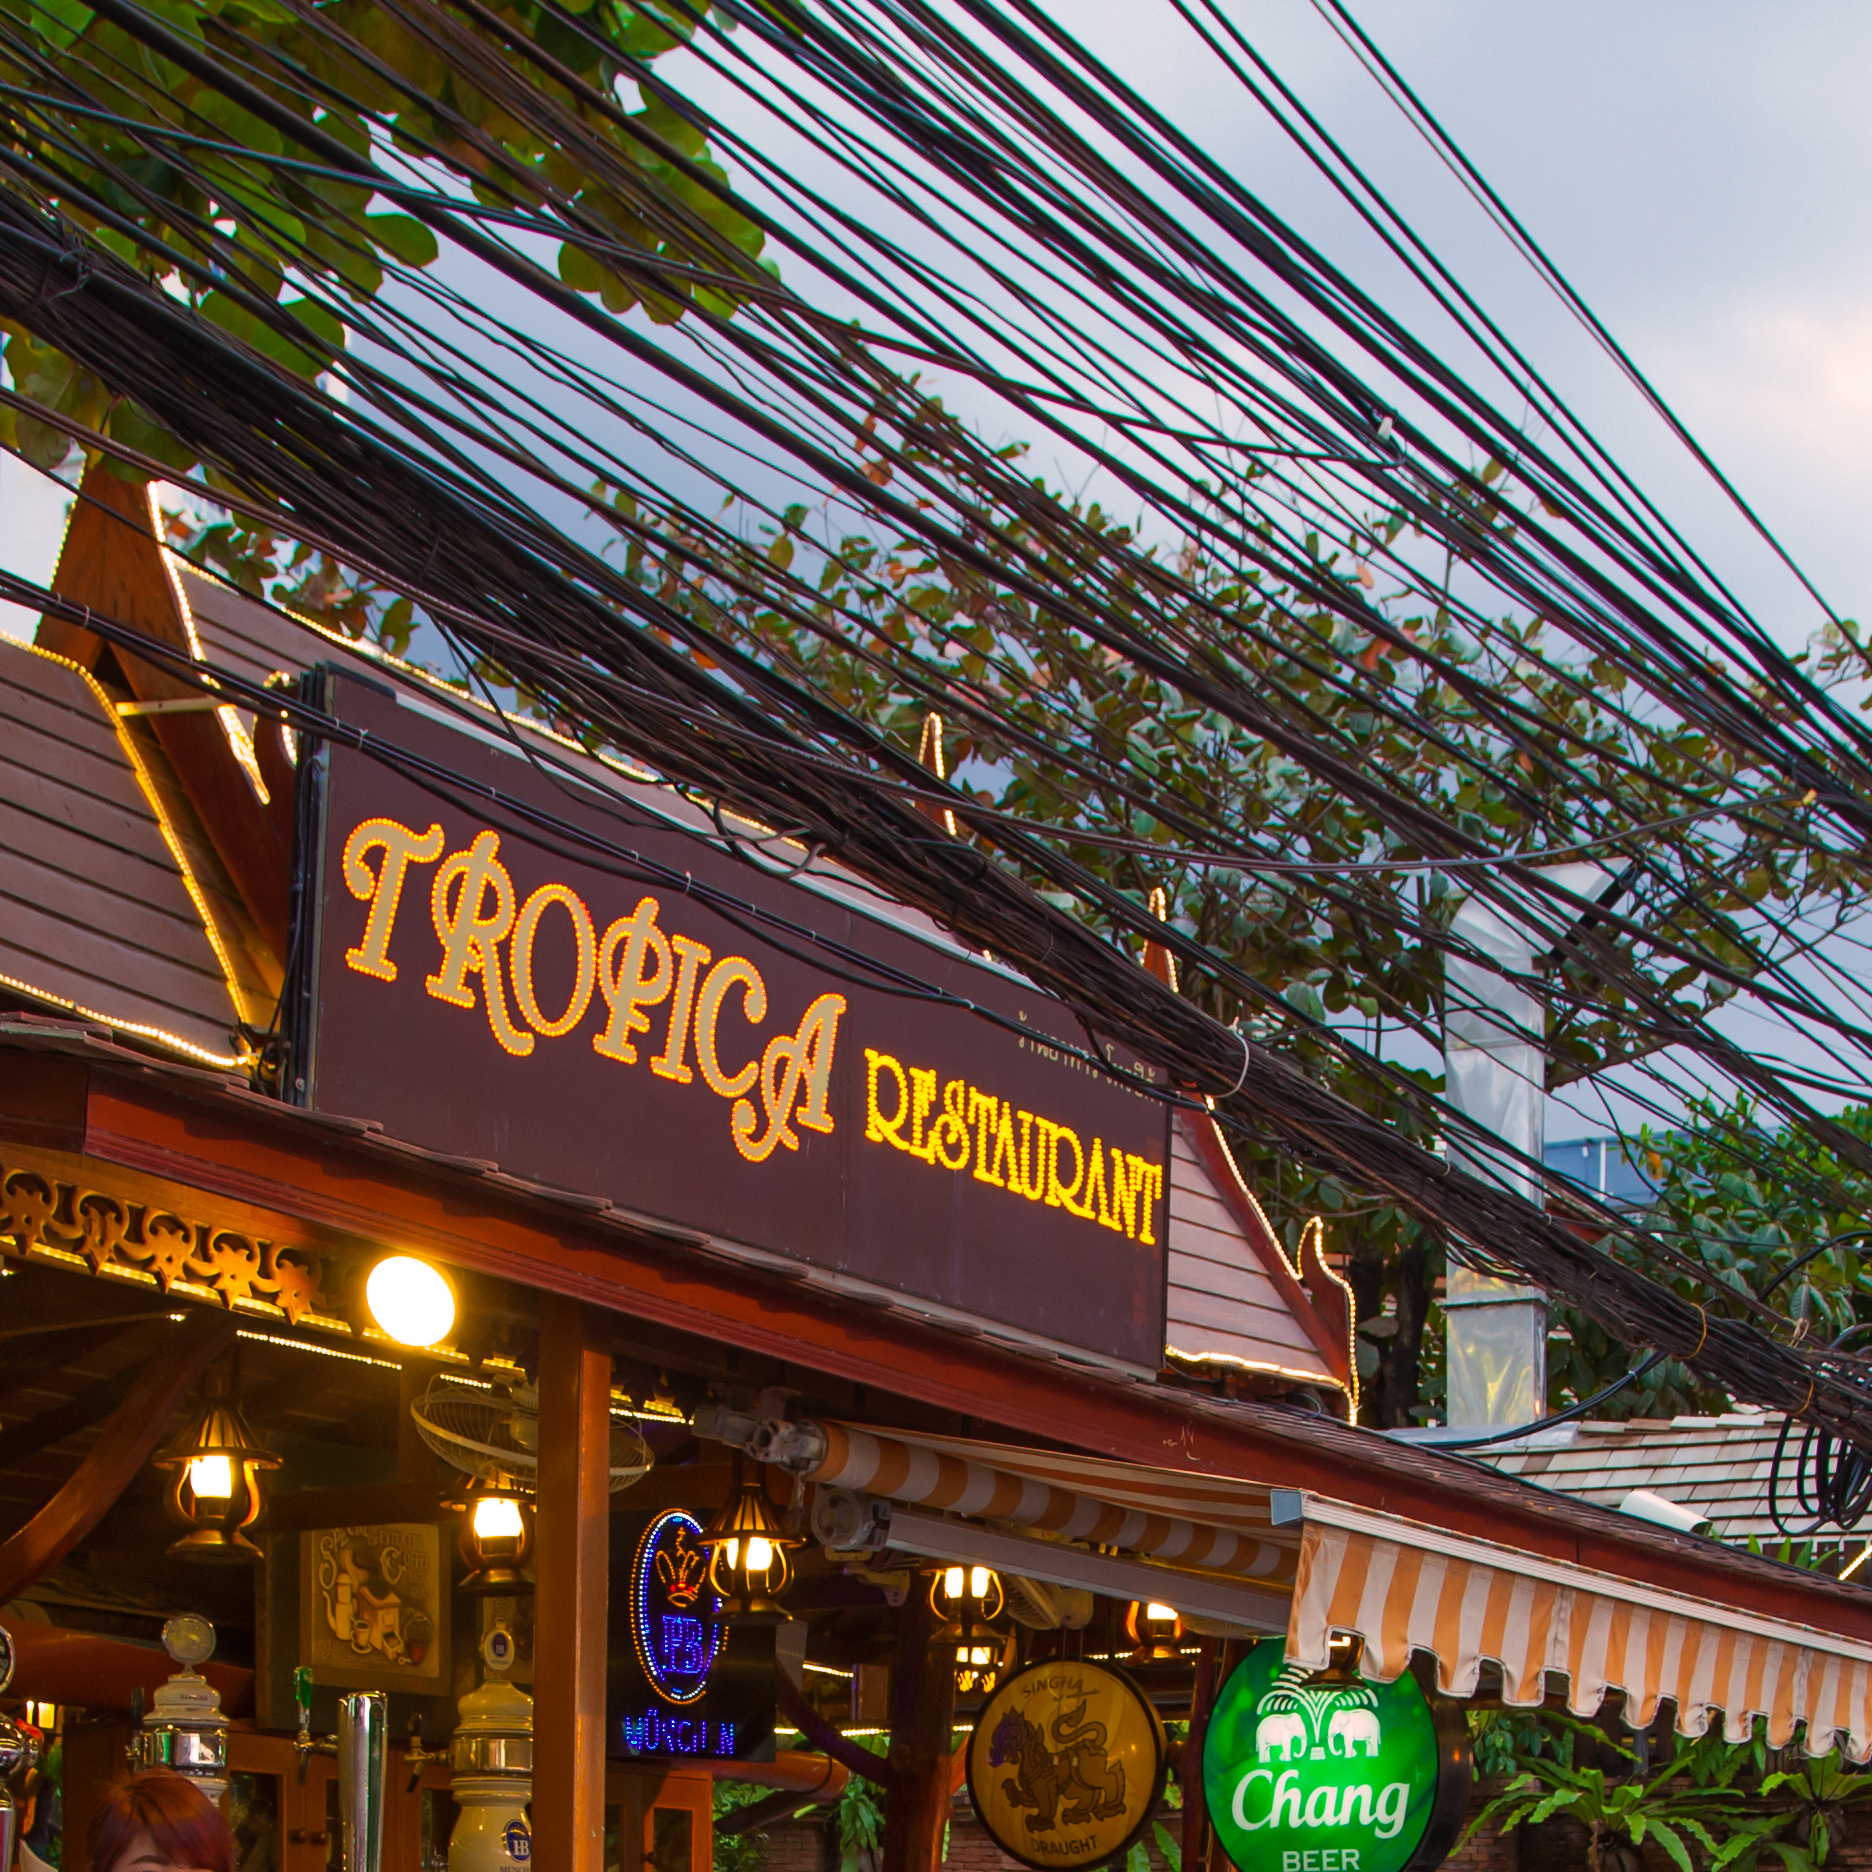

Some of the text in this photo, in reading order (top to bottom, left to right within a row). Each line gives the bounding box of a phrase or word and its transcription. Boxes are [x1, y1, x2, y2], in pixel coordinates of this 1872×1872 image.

[341, 817, 1164, 1246] TROPICA RESTAURANT
[1021, 1675, 1084, 1698] SINGHA
[1231, 1769, 1410, 1839] Chang
[1030, 1834, 1098, 1856] DRAUGHT
[1282, 1848, 1361, 1872] BEER
